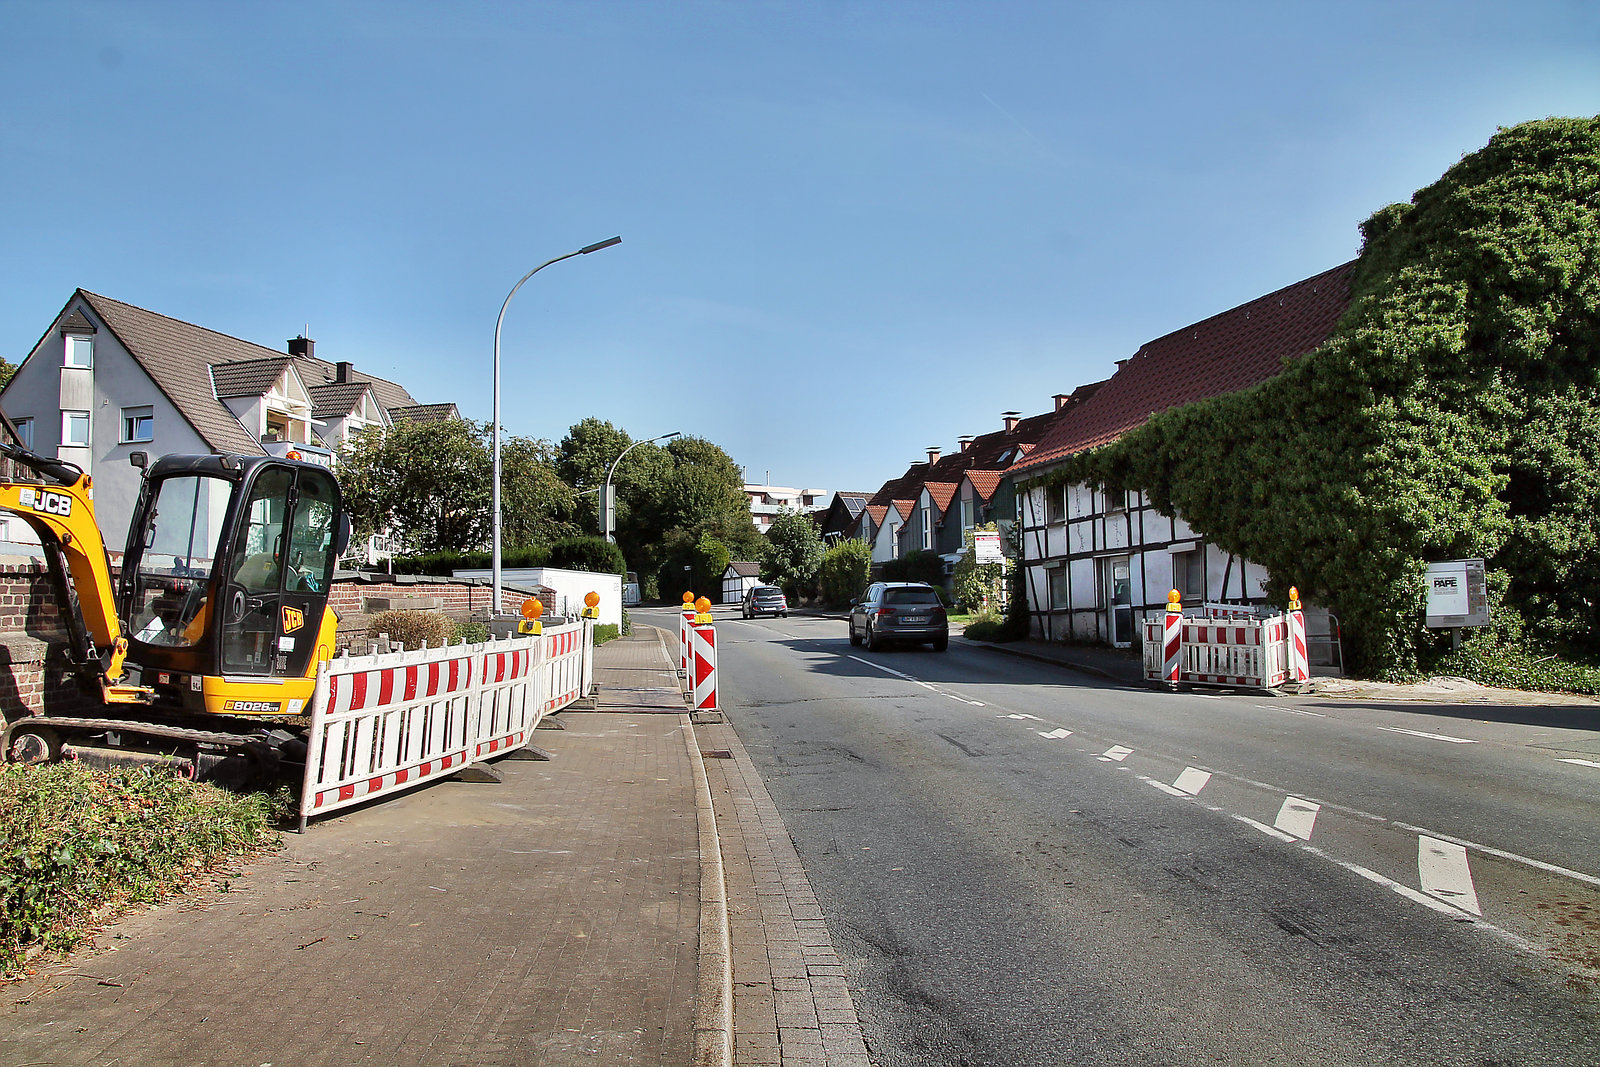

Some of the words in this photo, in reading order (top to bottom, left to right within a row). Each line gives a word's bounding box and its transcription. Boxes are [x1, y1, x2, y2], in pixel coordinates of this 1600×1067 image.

[35, 492, 71, 515] JCB
[1434, 579, 1457, 588] PAPE
[284, 608, 303, 631] JCB
[233, 701, 270, 712] 8026
